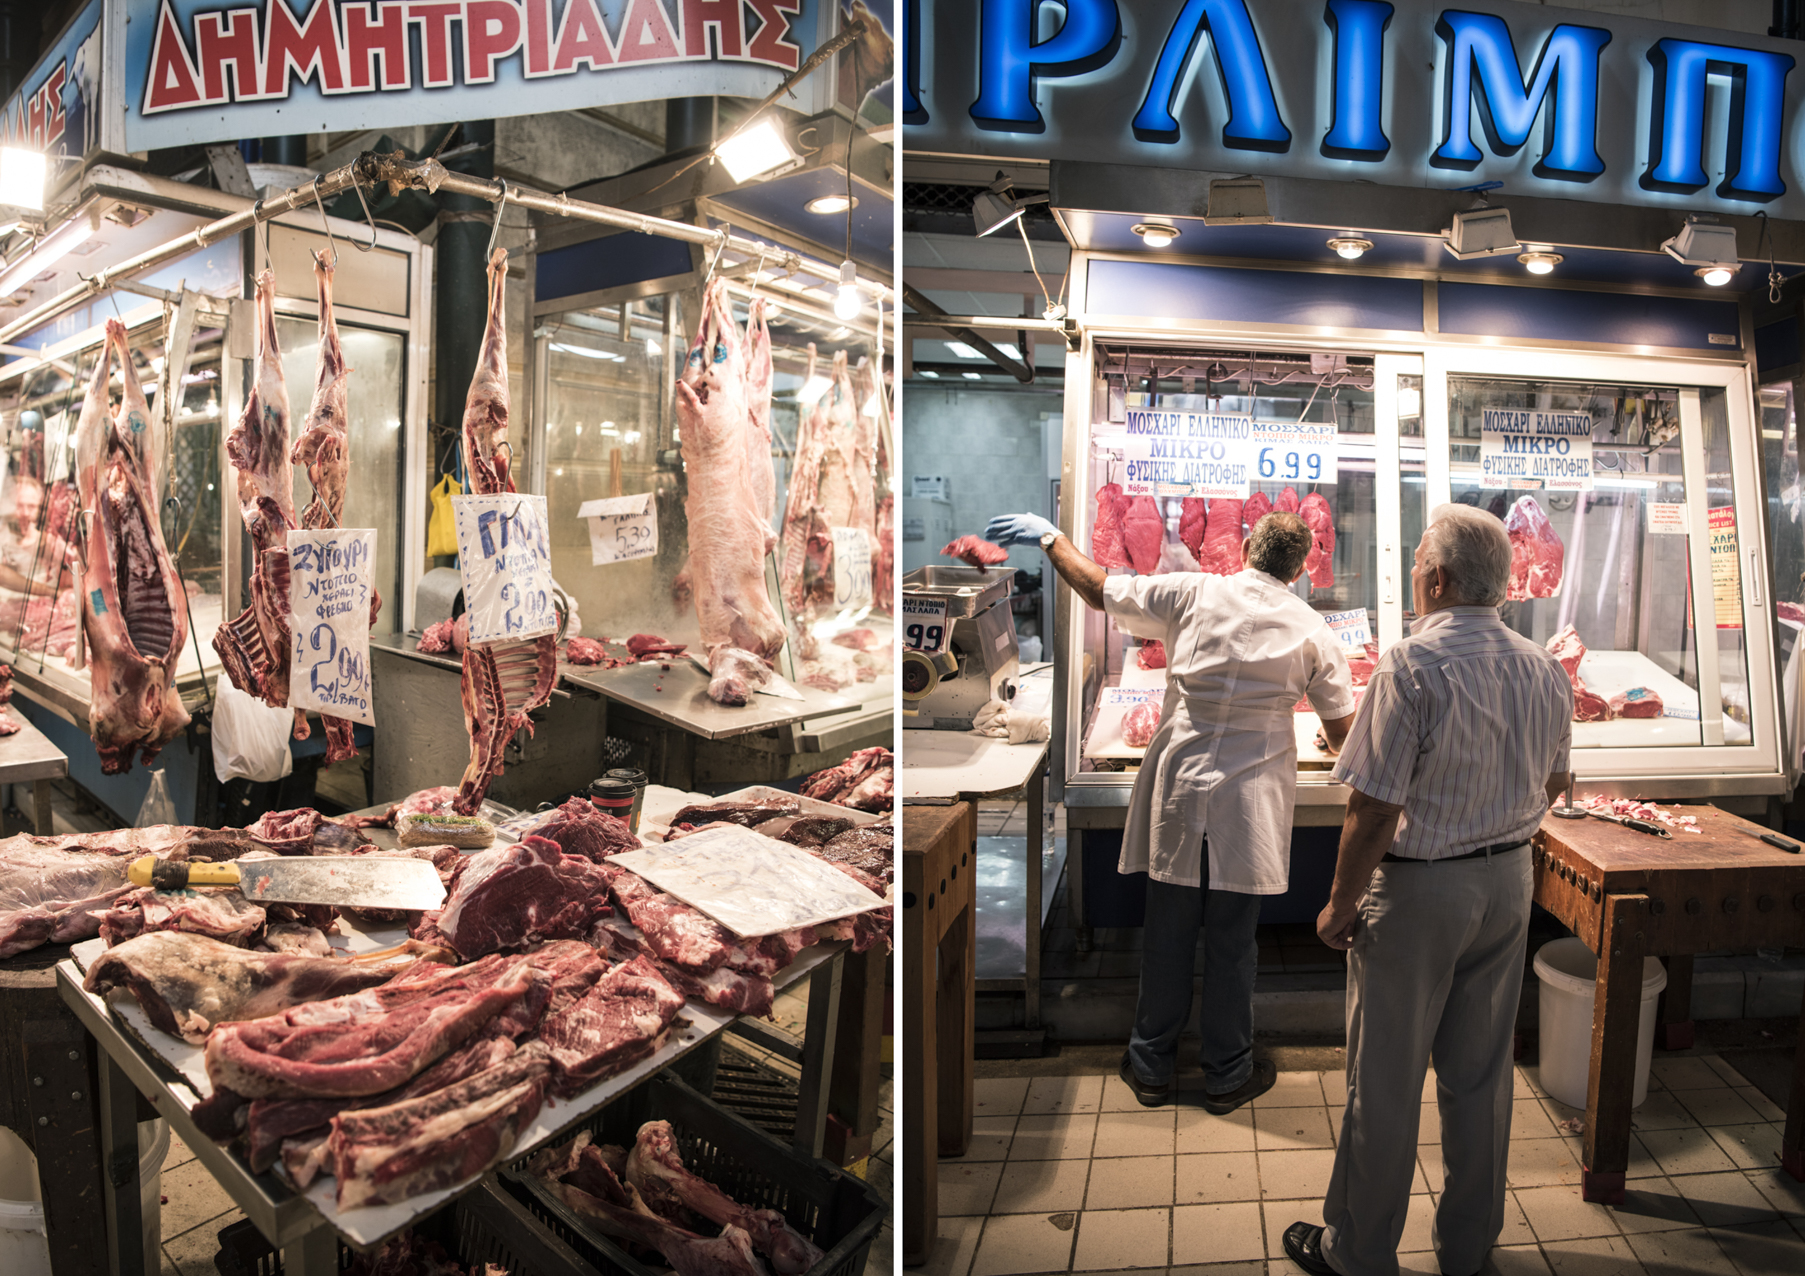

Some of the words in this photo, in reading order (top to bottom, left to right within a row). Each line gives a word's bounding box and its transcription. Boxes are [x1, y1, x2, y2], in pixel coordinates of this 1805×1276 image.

[140, 0, 801, 115] ΔΗΜΗΤΡΙΑΔΗΣ
[1126, 411, 1182, 436] ΜΟΣΧΑΡΙ
[1188, 415, 1250, 439] ΕΛΛΗΝΙΚΟ
[1252, 424, 1336, 435] ΜΟΣΧΑΡΙ
[1483, 410, 1530, 434] ΜΟΣΧΑΡΙ
[1536, 413, 1591, 436] ΕΛΛΗΝΙΚΟ
[1298, 433, 1334, 441] ΜΙΚΡΟ
[1503, 434, 1571, 455] ΜΙΚΡΟ
[1150, 438, 1226, 460] ΜΙΚΡΟ
[1126, 460, 1177, 483] ΦΥΣΙΚΗΣ
[1182, 462, 1246, 485] ΔΙΑΤΡΟΦΗΣ
[1257, 447, 1322, 479] 6.99
[1483, 455, 1527, 476] ΦΥΣΙΚΗΣ
[1532, 457, 1590, 477] ΔΙΑΤΡΟΦΗΣ
[1127, 484, 1149, 494] Νάξου
[303, 573, 358, 600] ΝΤΟΠΙΟ
